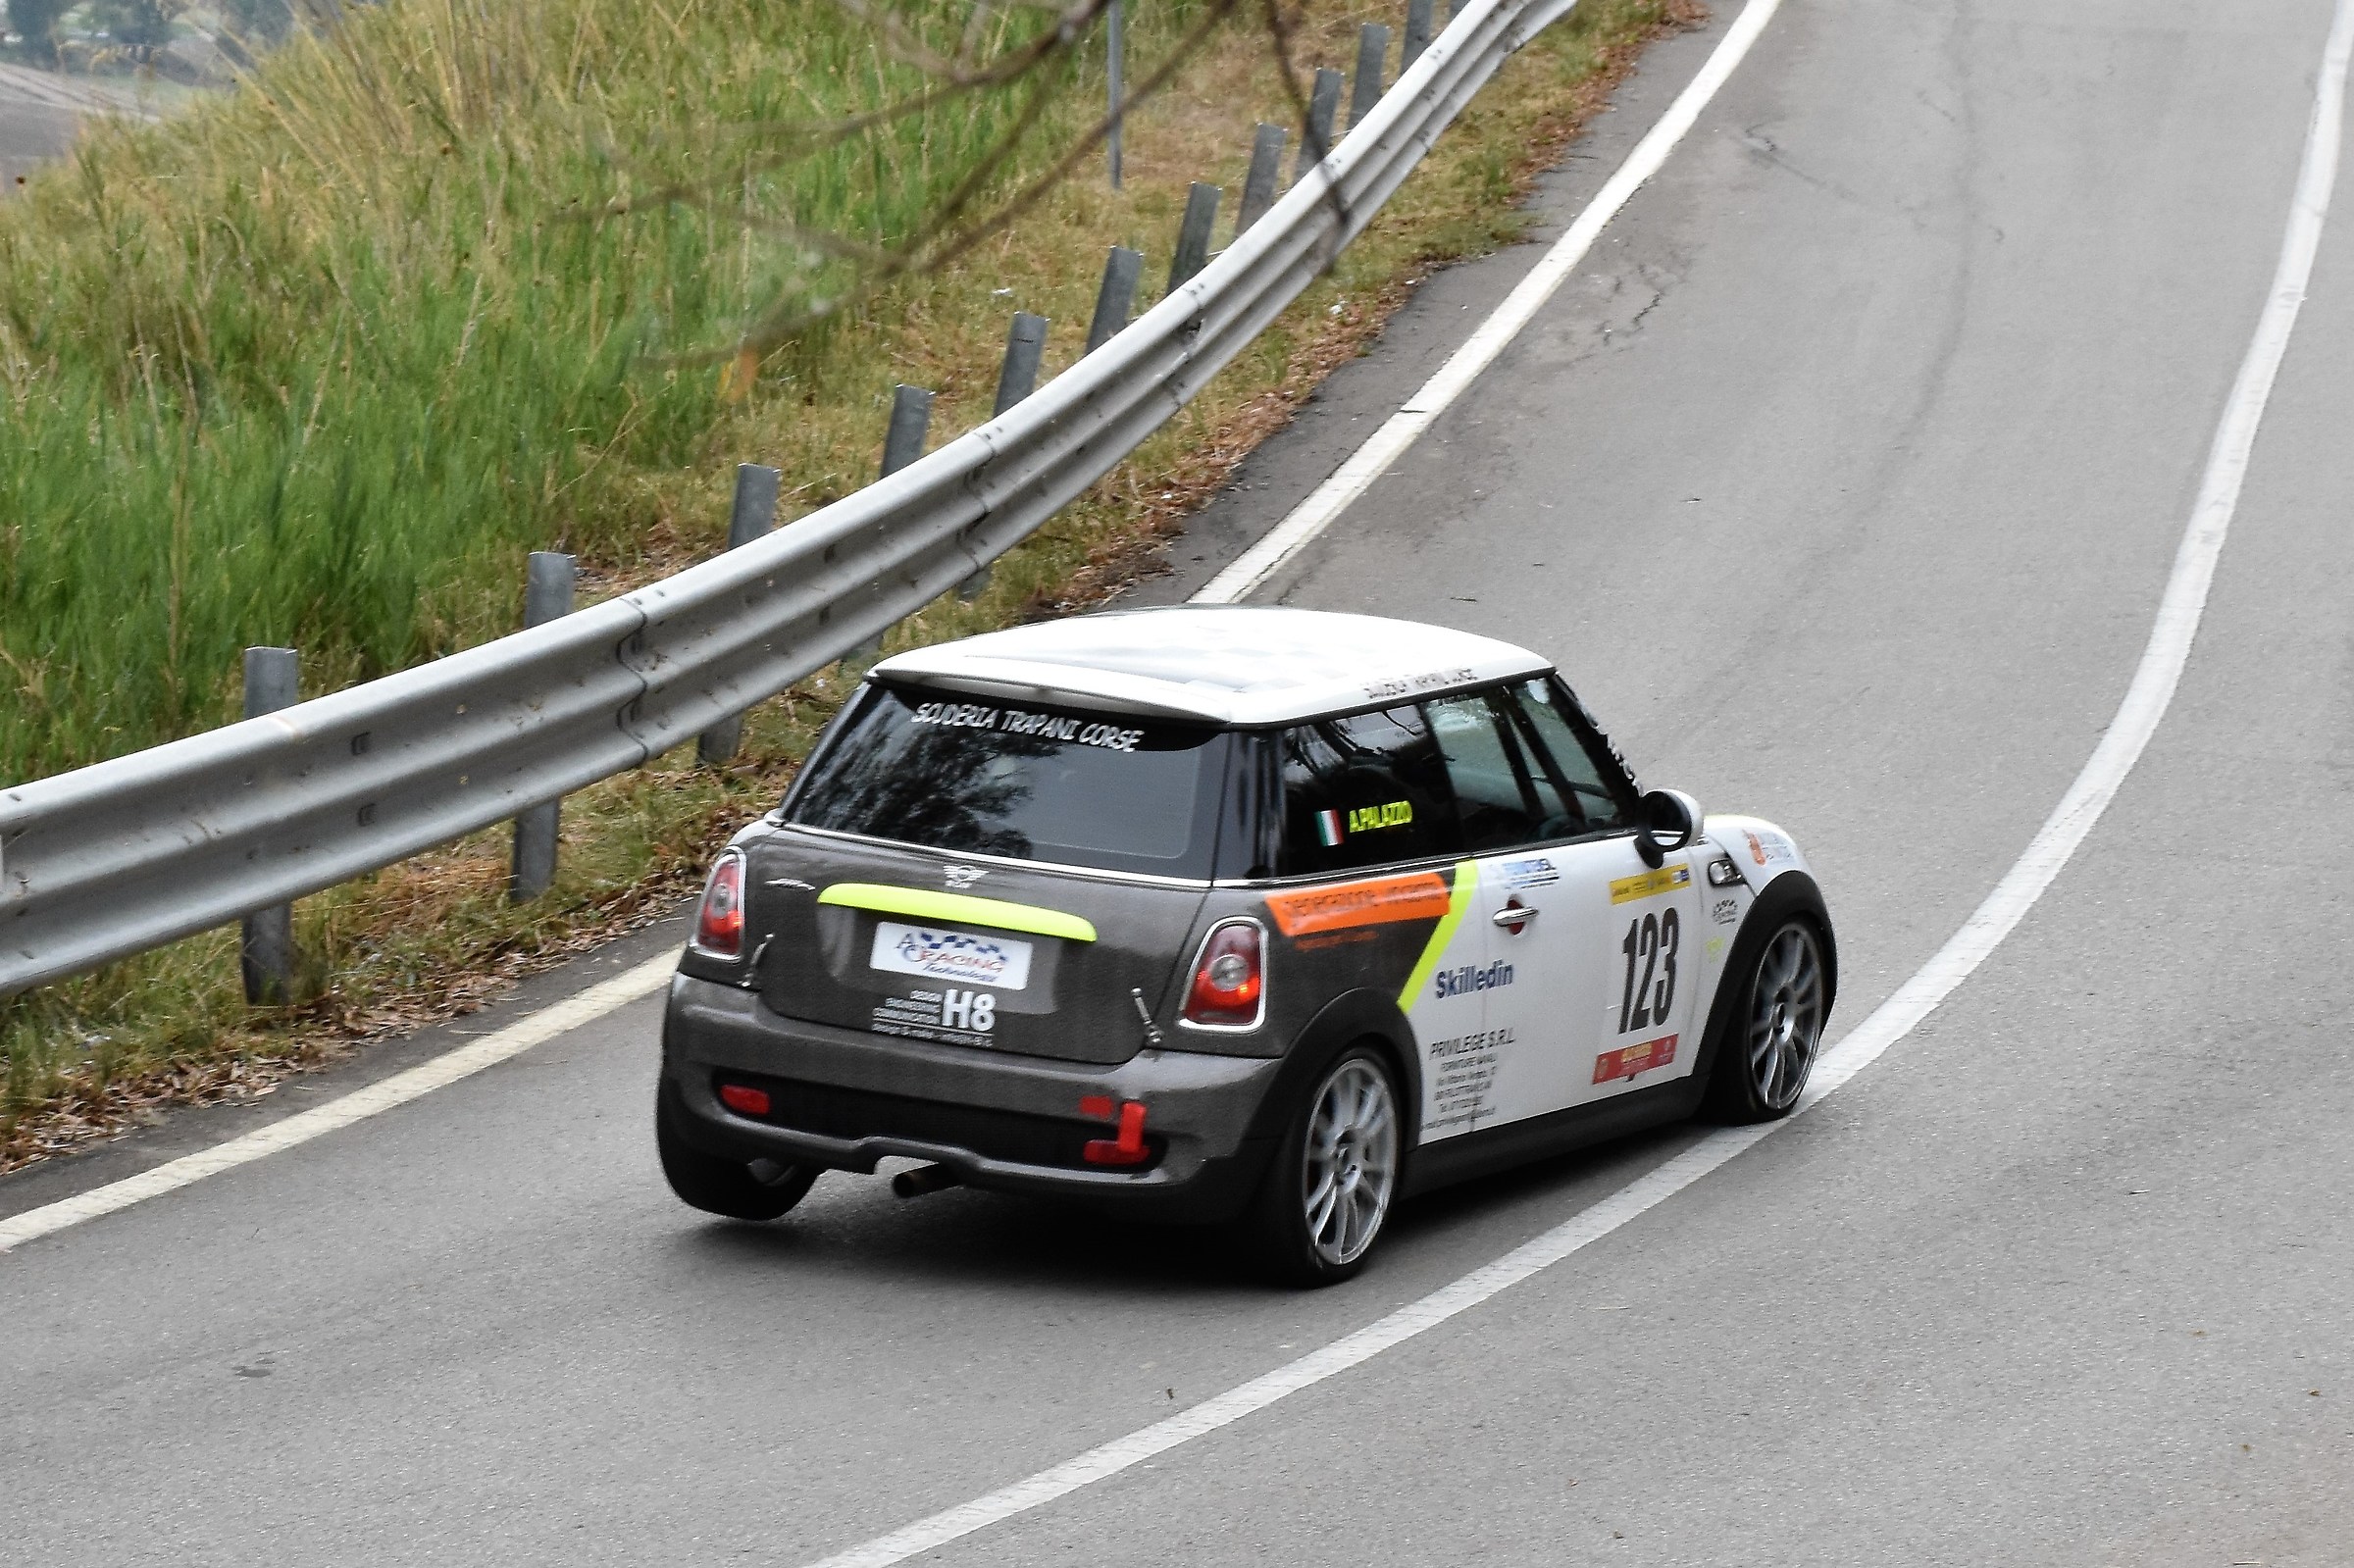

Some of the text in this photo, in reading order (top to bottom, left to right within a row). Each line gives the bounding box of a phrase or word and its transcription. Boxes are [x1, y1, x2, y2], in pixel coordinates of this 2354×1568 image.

[1000, 710, 1082, 740] TRAPANI
[1079, 723, 1145, 752] CORSE
[1618, 907, 1679, 1035] 123
[942, 988, 997, 1032] H8
[1429, 1032, 1486, 1060] PRIVILEGE
